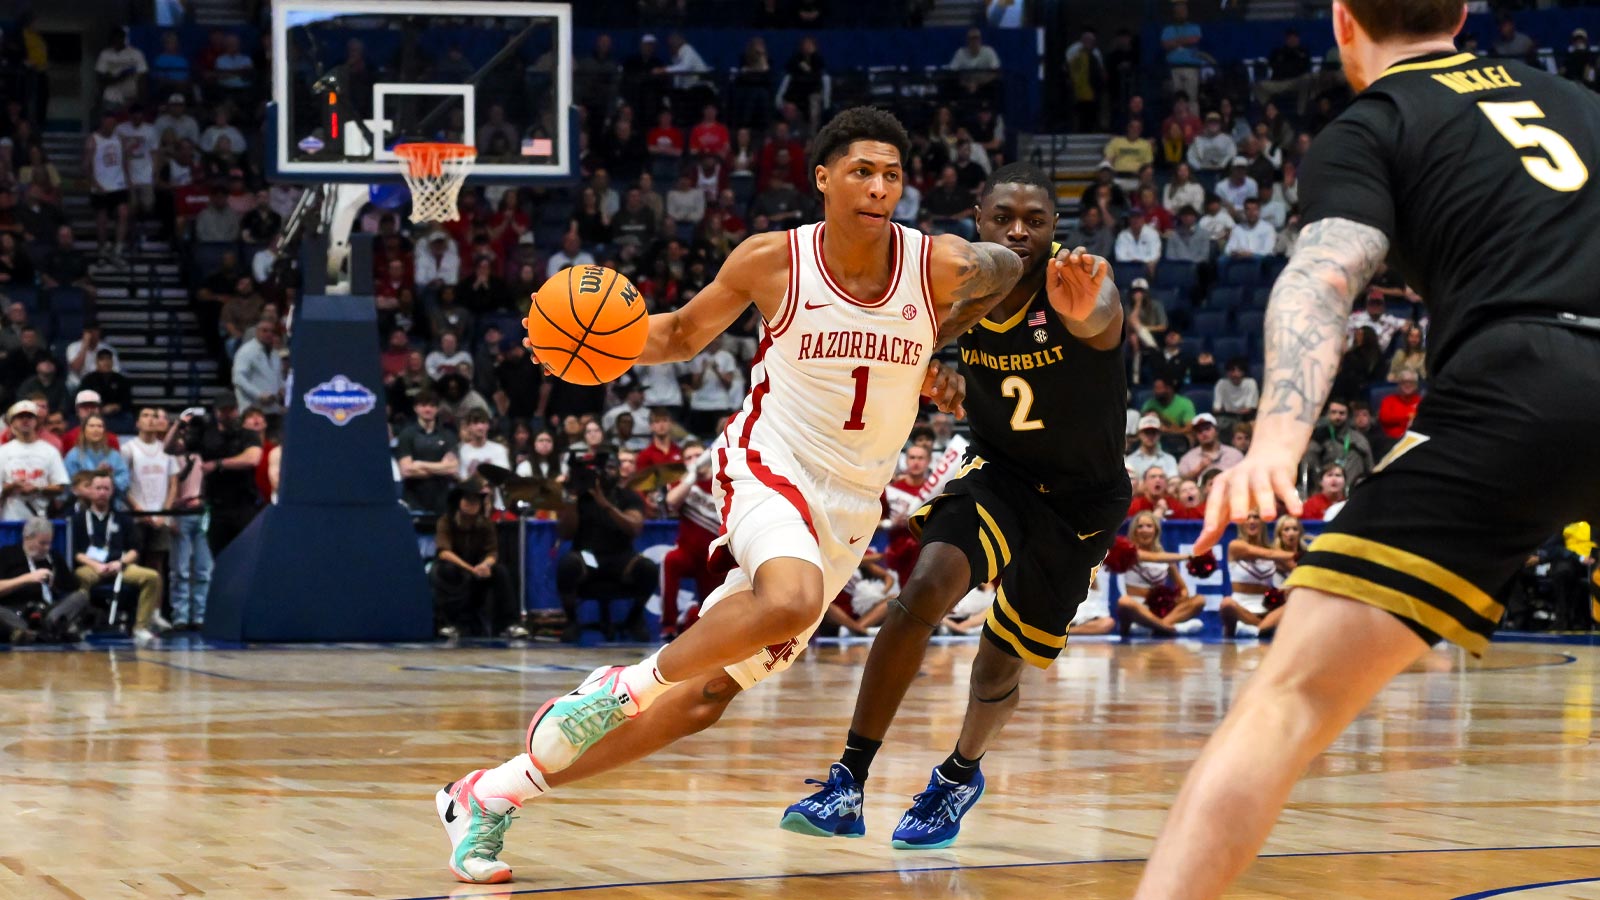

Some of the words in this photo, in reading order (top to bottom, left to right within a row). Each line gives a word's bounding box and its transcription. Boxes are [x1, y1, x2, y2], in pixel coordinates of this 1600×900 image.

[1476, 100, 1589, 192] 5
[902, 304, 917, 320] SEC
[798, 331, 923, 366] RAZORBACKS
[1034, 328, 1048, 343] SEC
[960, 345, 1064, 371] VANDERBILT
[843, 366, 870, 430] 1
[1001, 375, 1045, 431] 2
